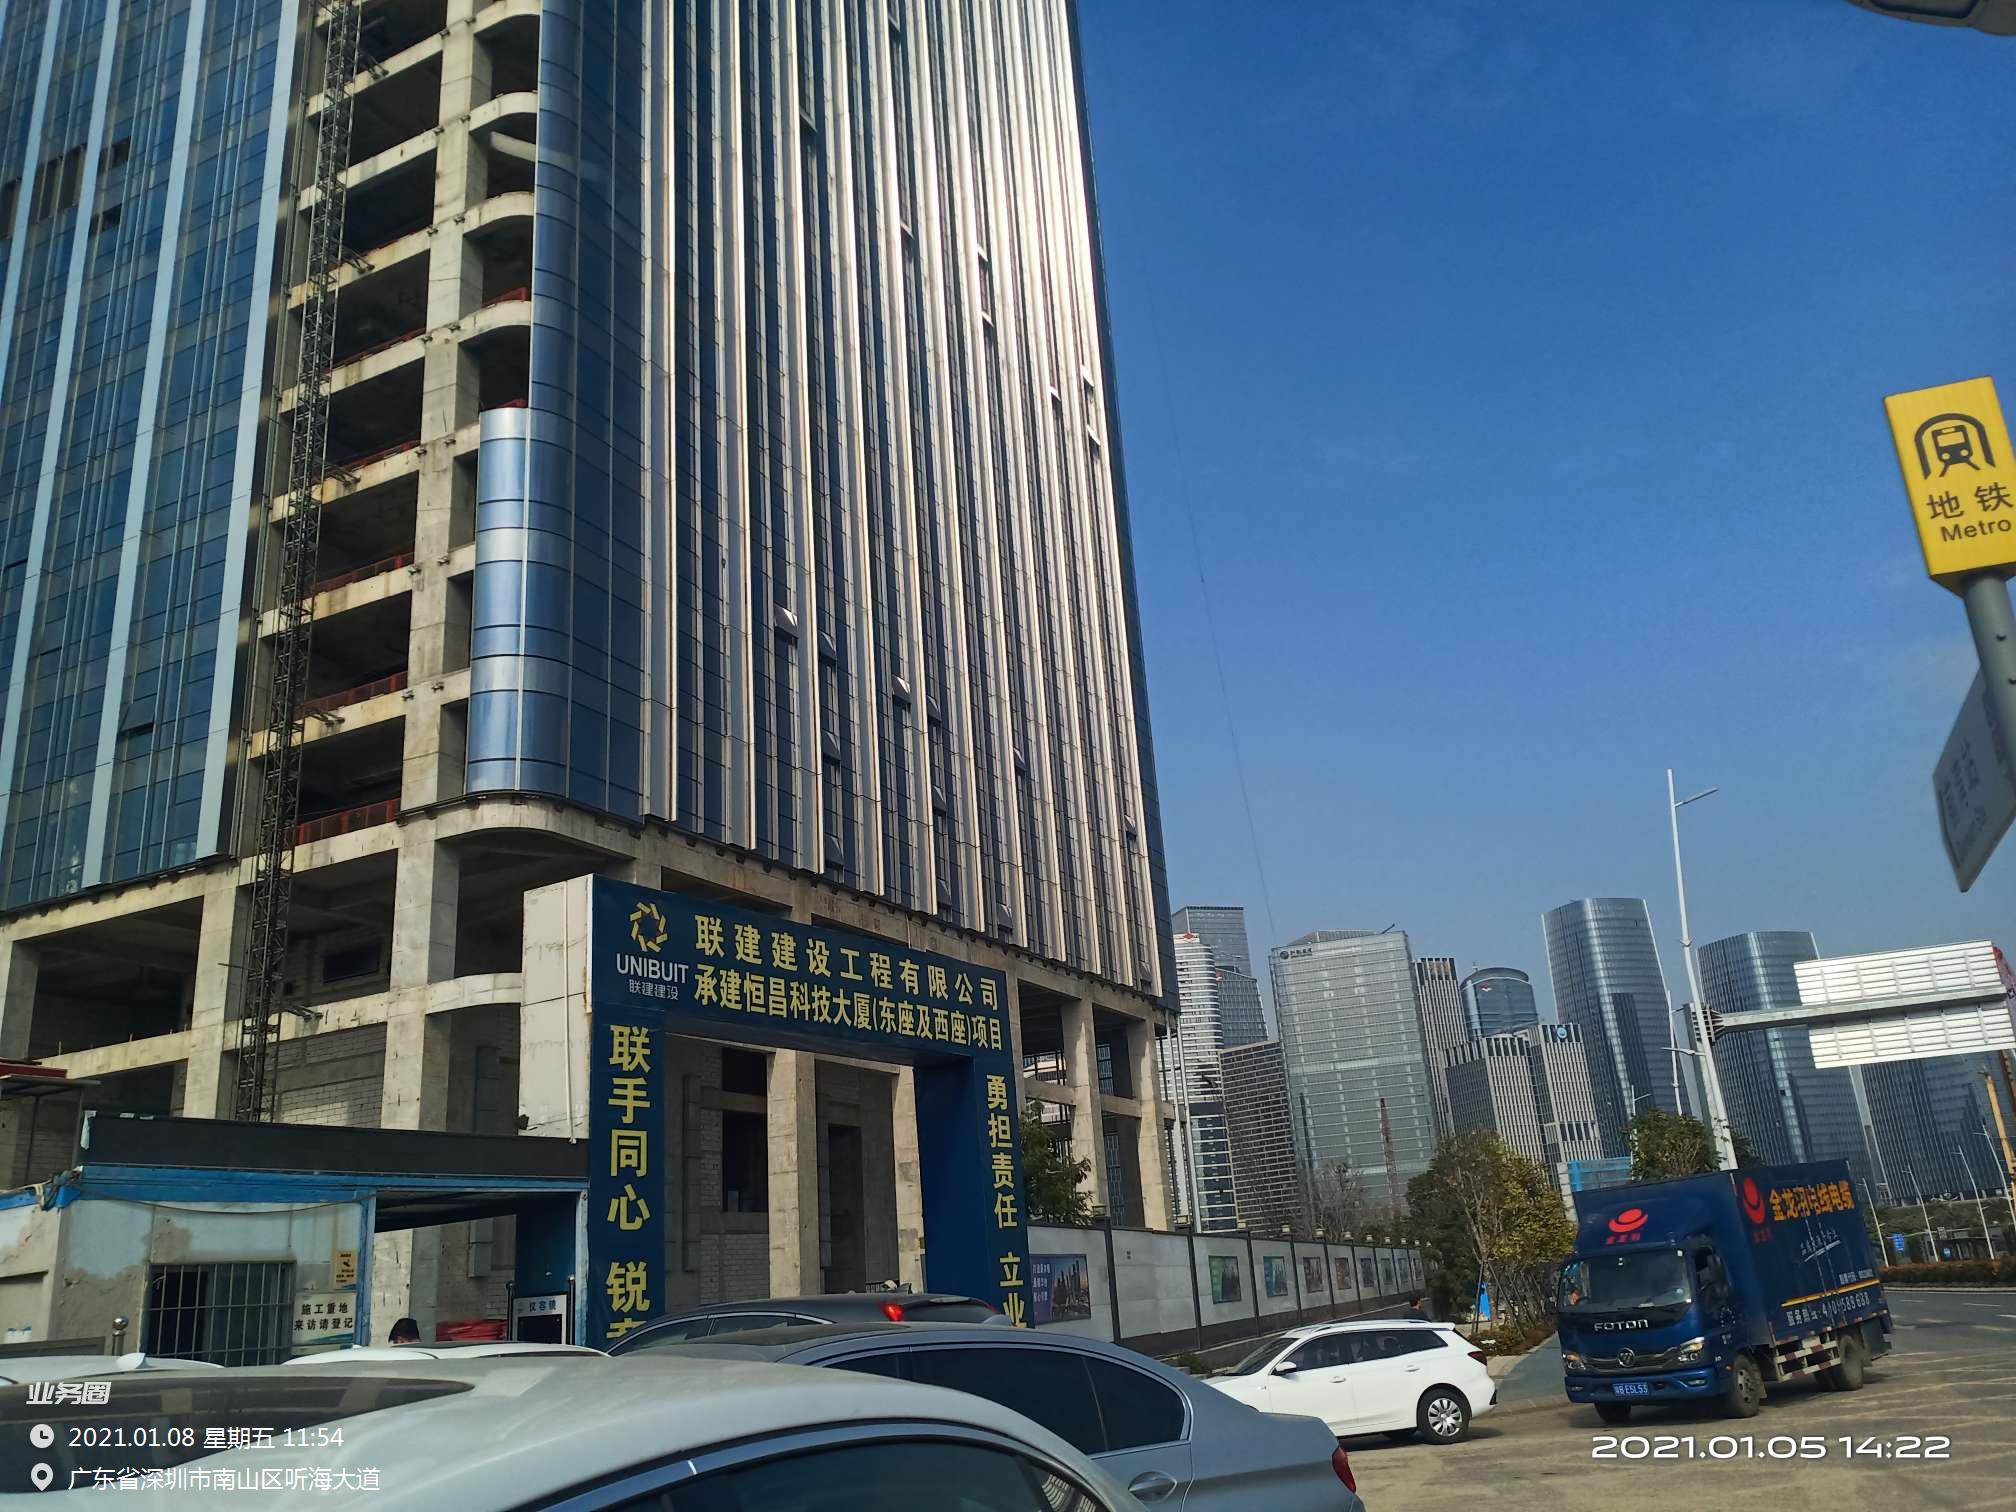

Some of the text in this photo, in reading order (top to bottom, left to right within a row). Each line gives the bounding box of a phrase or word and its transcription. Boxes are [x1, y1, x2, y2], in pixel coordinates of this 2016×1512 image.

[1927, 482, 2014, 520] 地铁
[1941, 518, 2011, 542] Metro
[616, 953, 688, 984] UNIBUIT
[694, 913, 999, 1011] 联建建设工程有限公司
[628, 979, 680, 1001] 联建建设
[607, 1024, 651, 1231] 联手同心
[986, 1074, 1018, 1229] 勇担责任
[301, 1302, 348, 1315] 施工重地
[294, 1317, 353, 1331] 来访请登记
[1593, 1318, 1649, 1332] FOTON
